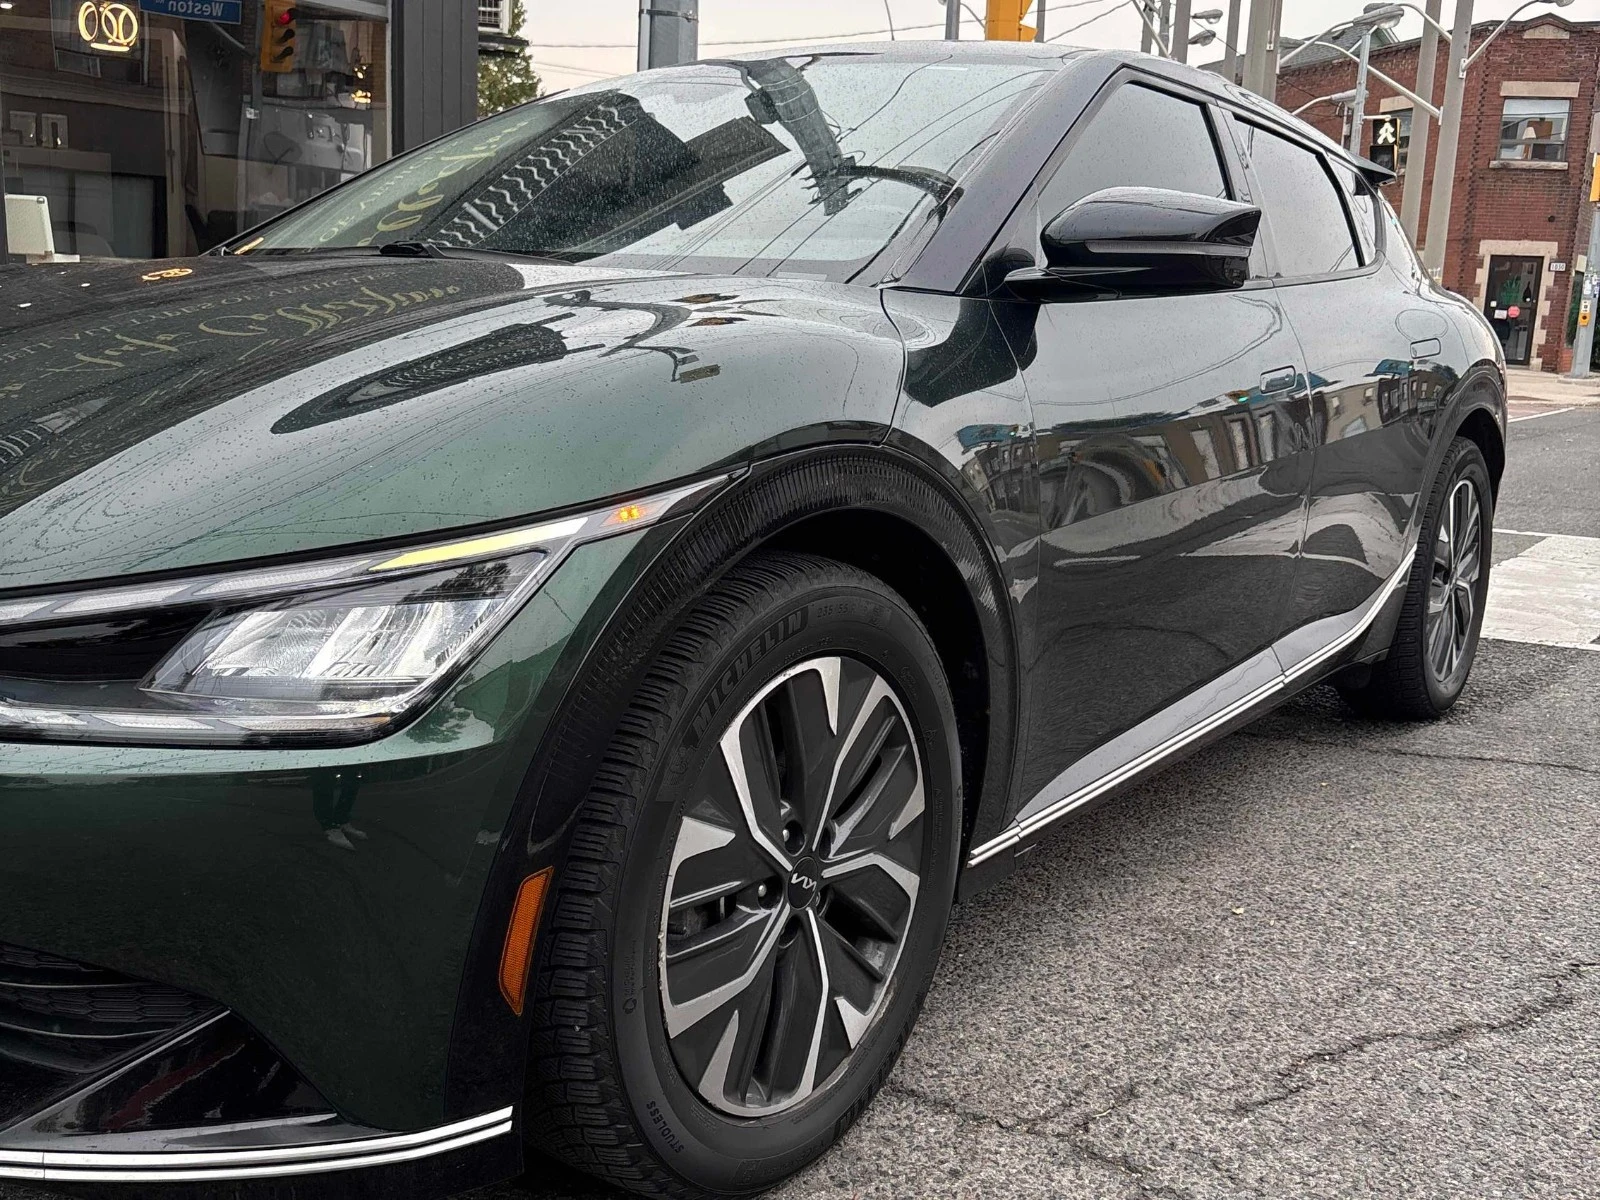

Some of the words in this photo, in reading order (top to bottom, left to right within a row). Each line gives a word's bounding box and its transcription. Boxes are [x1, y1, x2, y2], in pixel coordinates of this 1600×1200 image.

[692, 611, 802, 740] MICHELIN
[790, 872, 817, 892] KIA
[646, 1100, 685, 1154] STUDLESS
